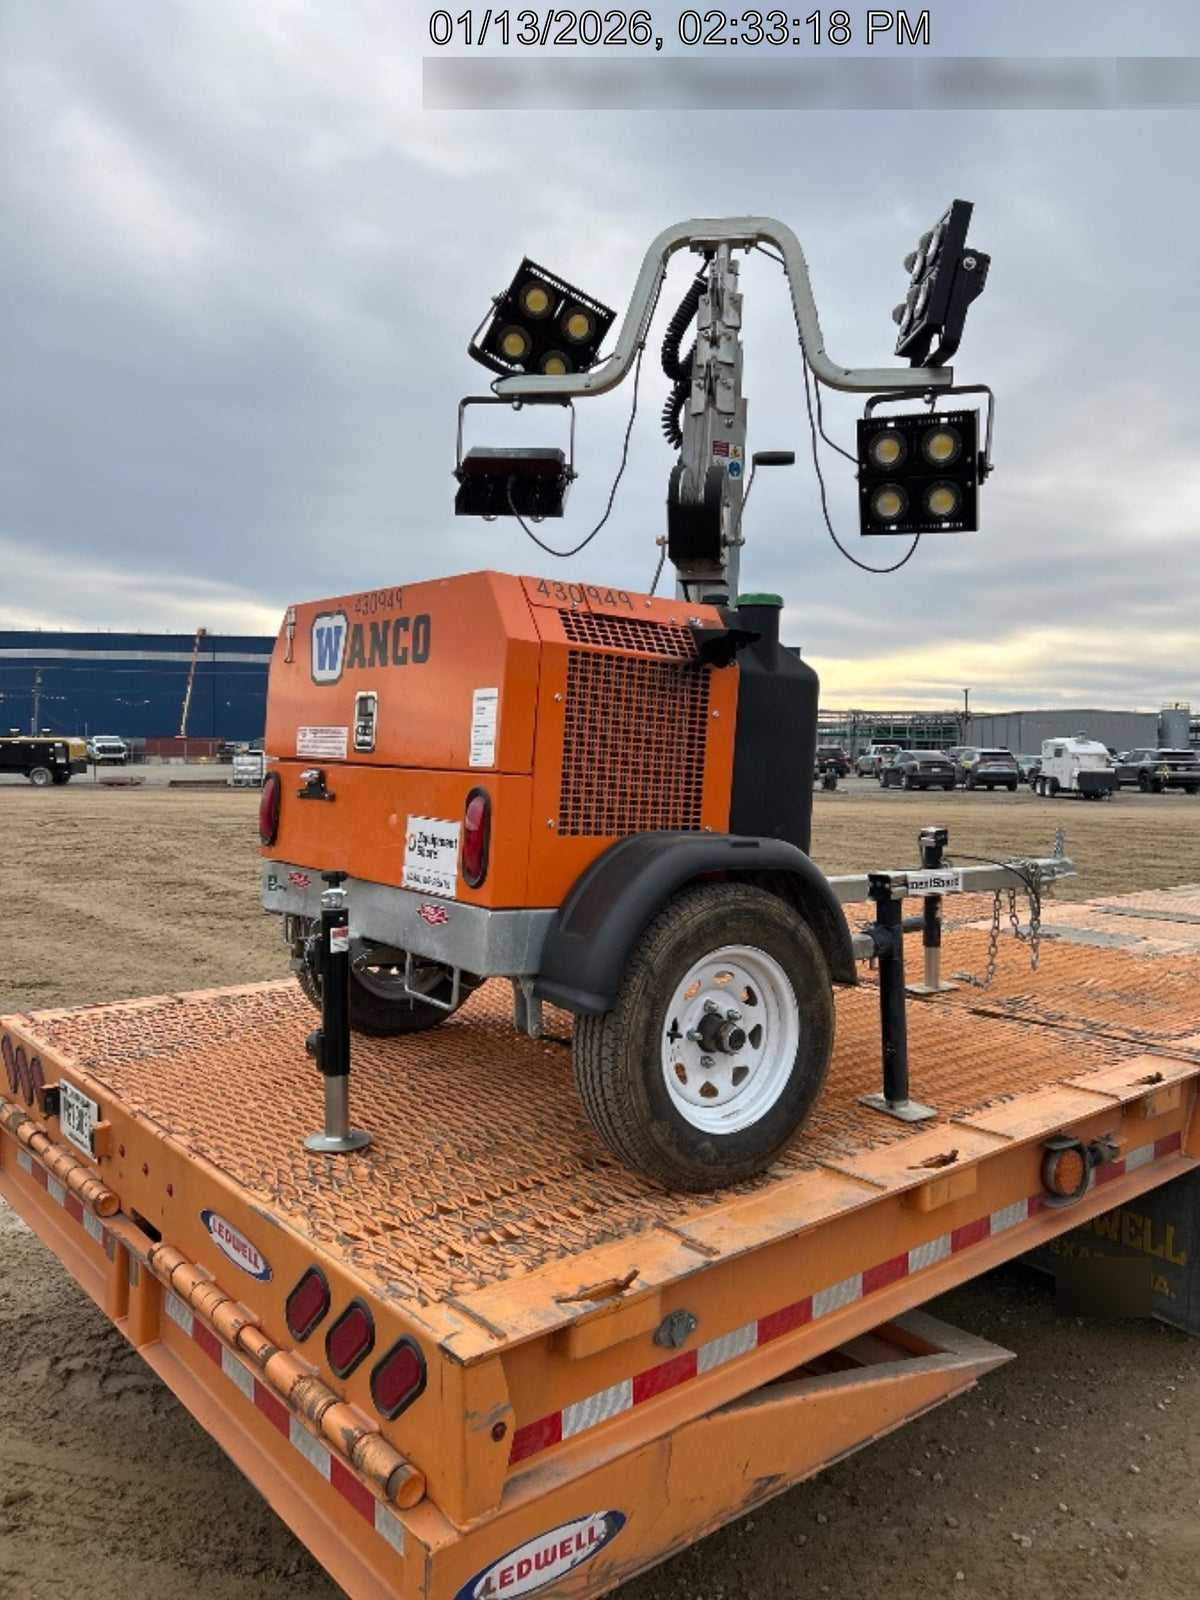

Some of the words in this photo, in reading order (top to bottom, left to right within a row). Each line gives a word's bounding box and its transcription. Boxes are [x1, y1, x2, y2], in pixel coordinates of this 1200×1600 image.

[537, 579, 634, 610] 430949
[315, 614, 431, 670] WANCO
[212, 1216, 260, 1270] LEDWELL
[1080, 1208, 1188, 1266] WELL
[484, 1525, 600, 1596] LEDWELL
